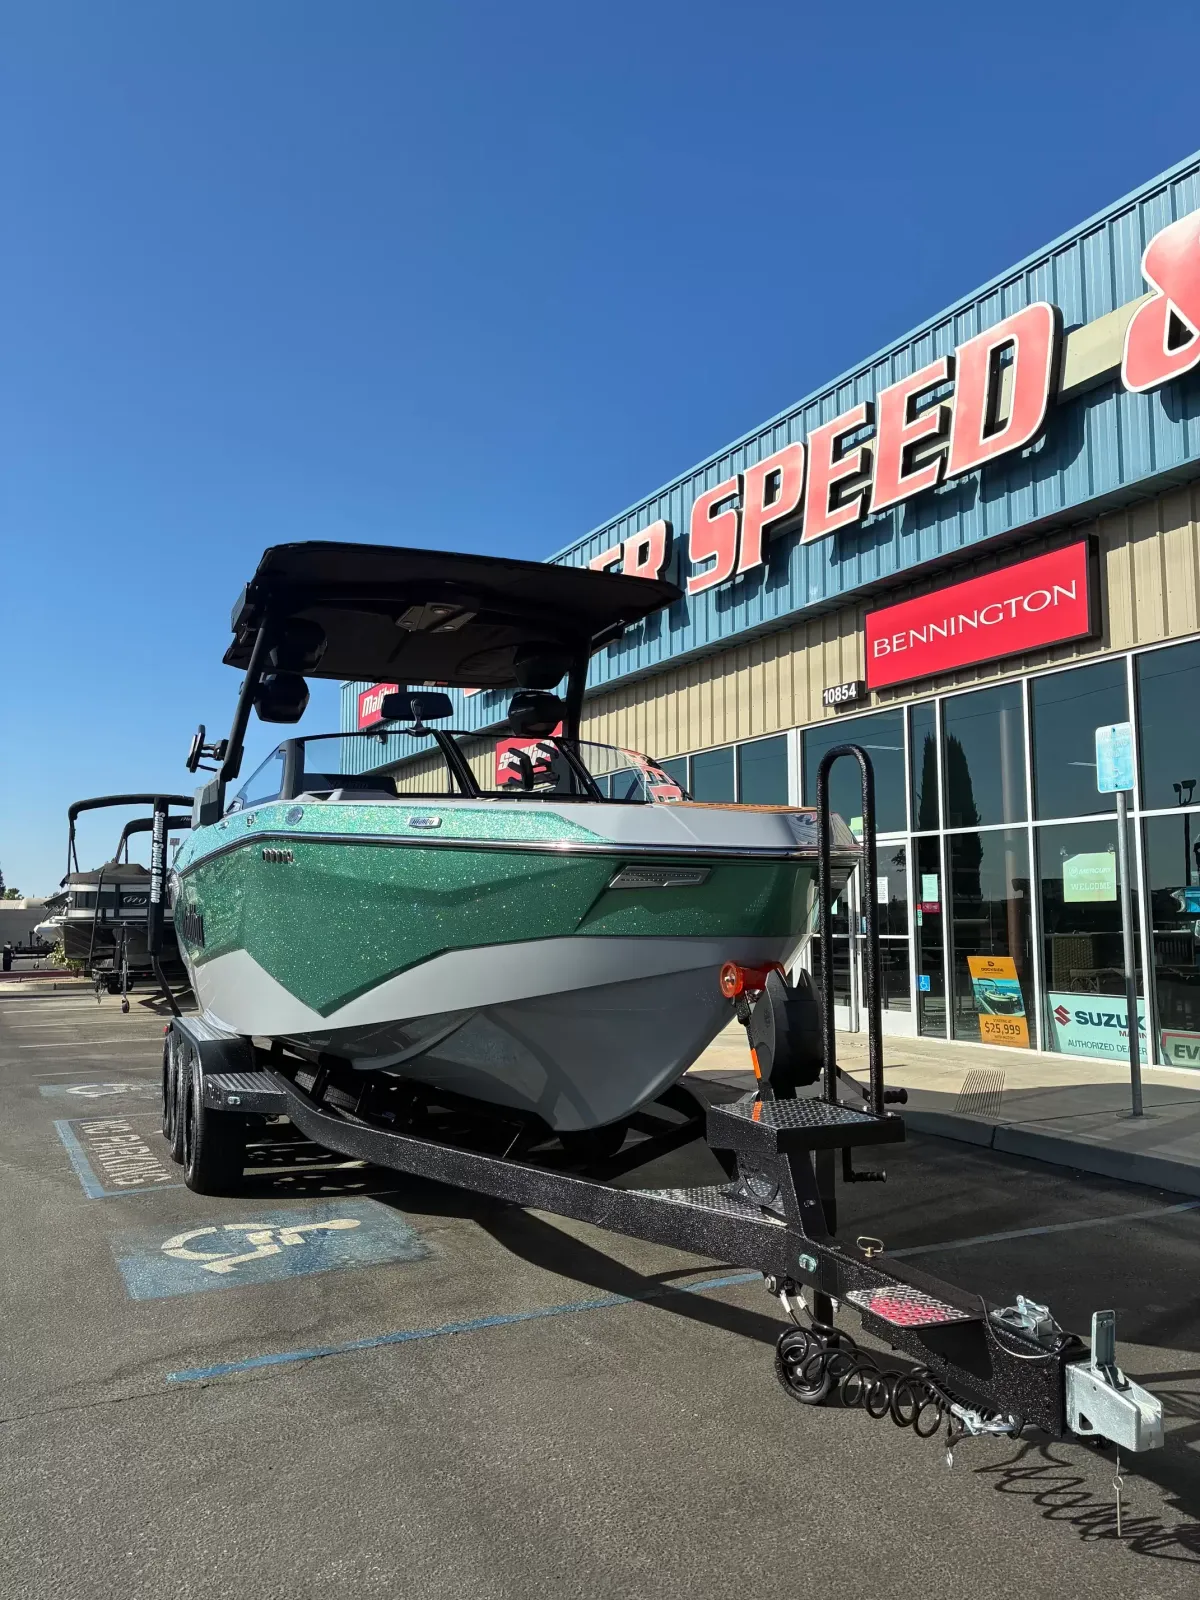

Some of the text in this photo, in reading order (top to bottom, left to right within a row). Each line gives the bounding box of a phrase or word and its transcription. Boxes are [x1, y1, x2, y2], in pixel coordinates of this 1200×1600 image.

[687, 301, 1056, 595] SPEED
[873, 580, 1077, 658] BENNINGTON
[823, 683, 857, 704] 10854
[153, 811, 166, 842] Semper
[152, 842, 164, 868] Speed
[150, 875, 163, 904] Marine
[1070, 882, 1112, 891] WELCOME
[984, 1020, 1021, 1036] $25,999
[1074, 1010, 1147, 1031] SUZUK
[1119, 1030, 1147, 1039] MIN
[1067, 1039, 1148, 1056] AUTHORIZED DEER
[80, 1119, 172, 1186] NO PARKING
